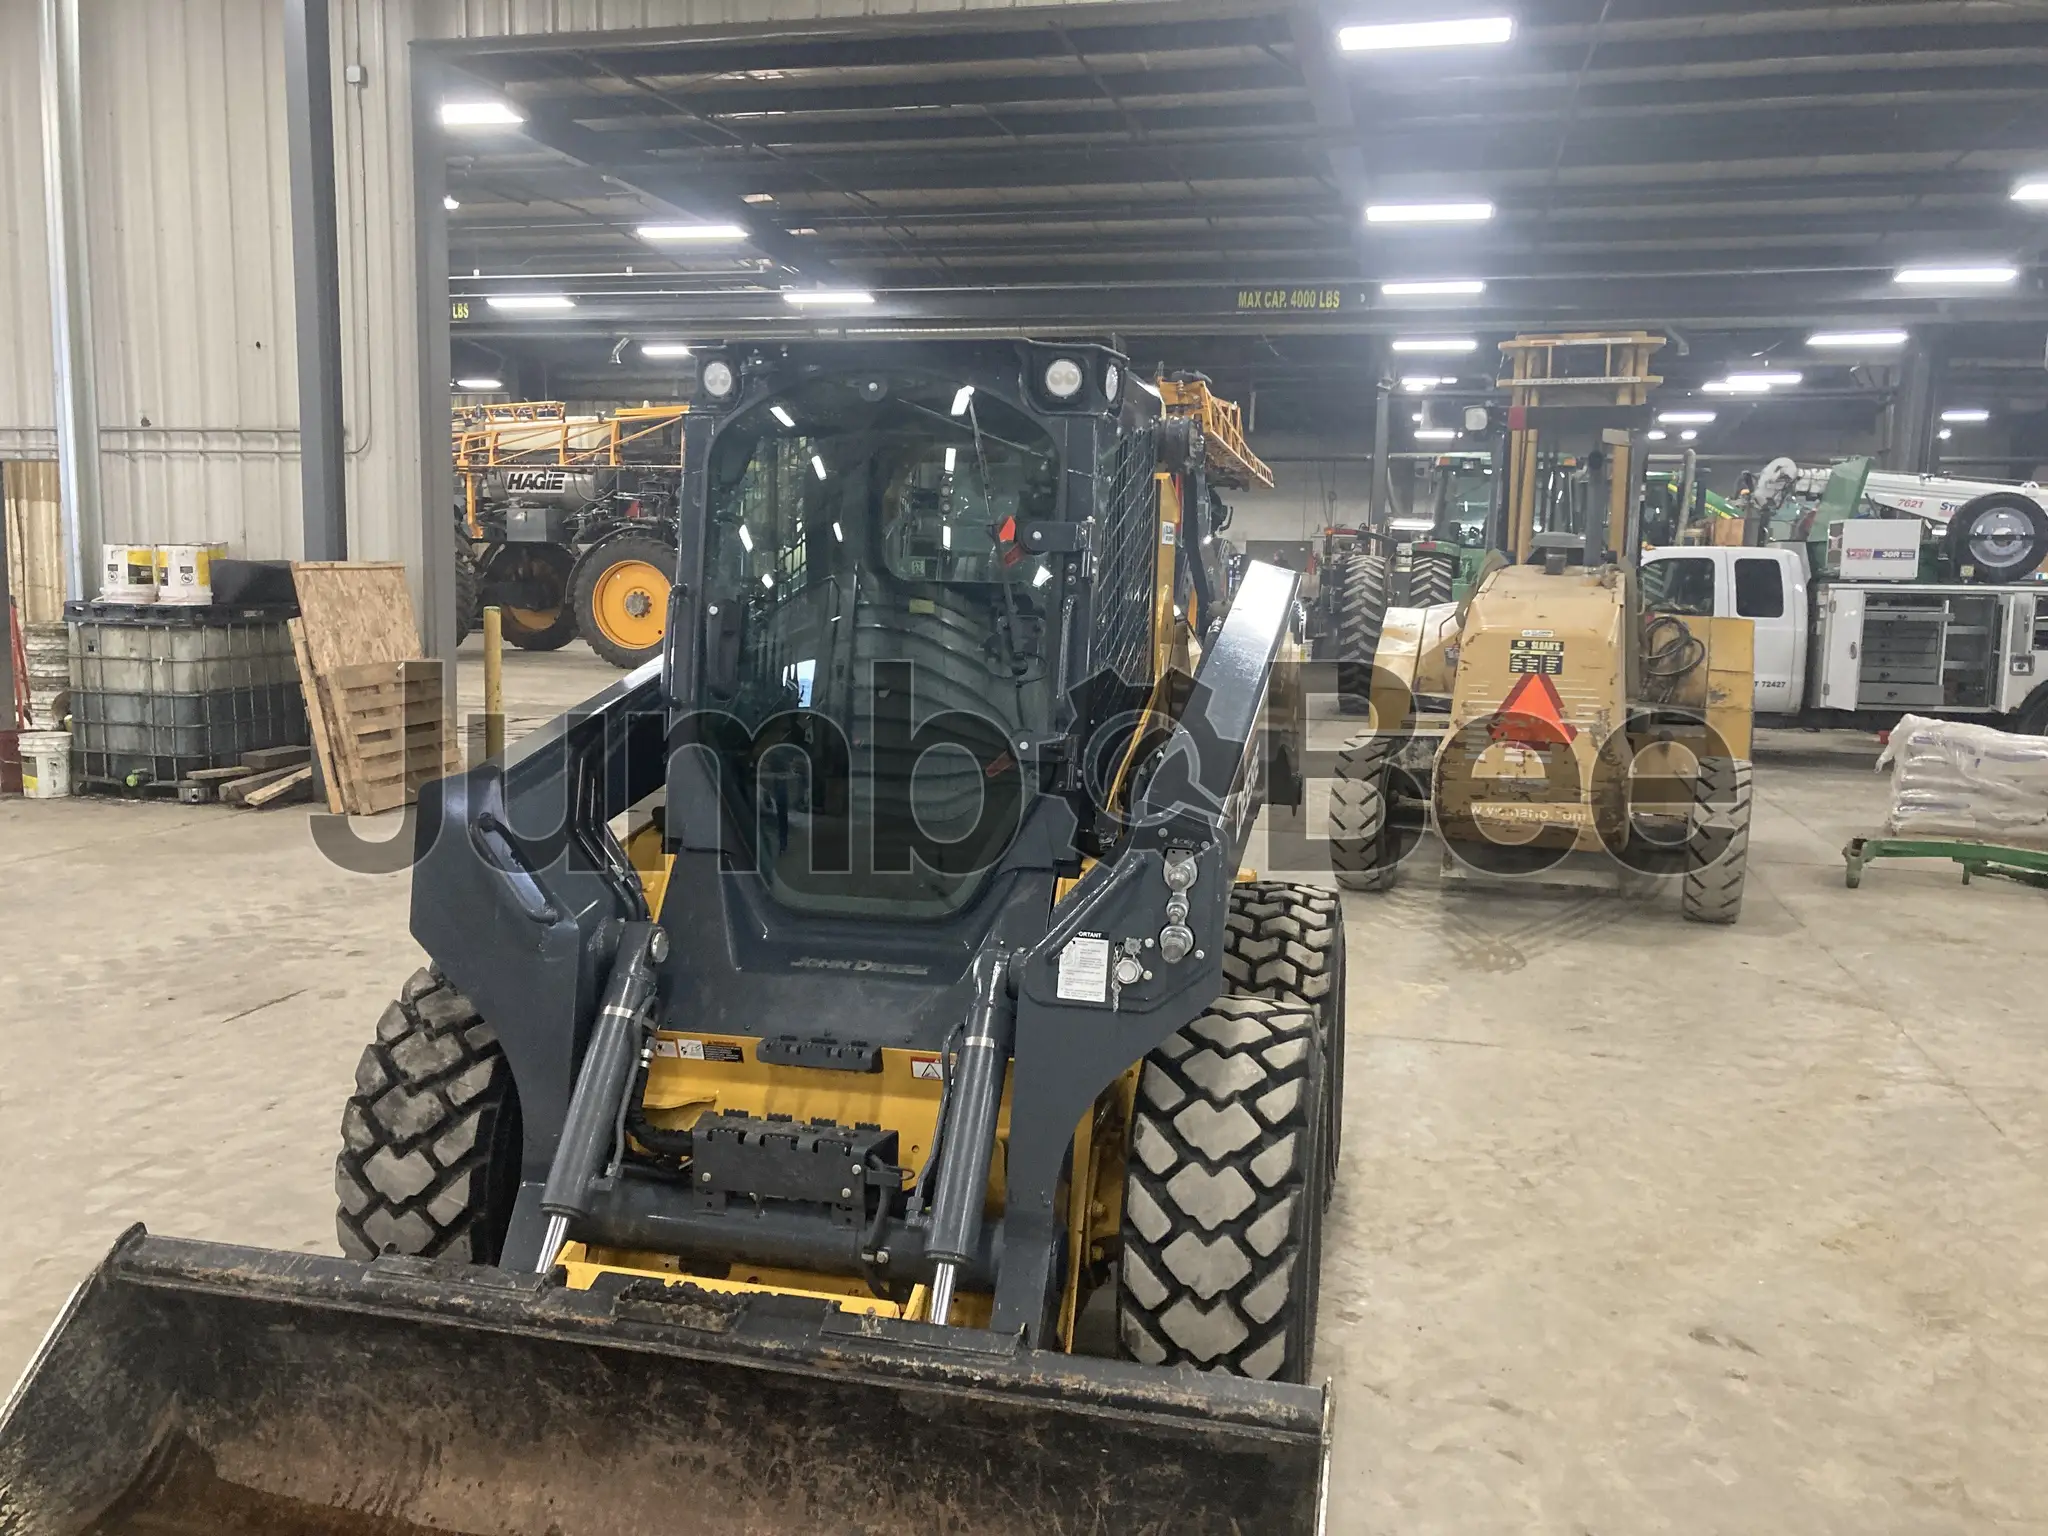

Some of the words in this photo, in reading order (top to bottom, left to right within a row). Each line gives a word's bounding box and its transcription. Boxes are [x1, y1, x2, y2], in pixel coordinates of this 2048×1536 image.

[1238, 291, 1262, 309] MAX
[1264, 291, 1287, 309] CAP.
[1290, 289, 1317, 309] 4000
[1319, 289, 1340, 308] LBS
[452, 302, 469, 319] LBS
[1897, 498, 1923, 509] 7621
[1761, 680, 1787, 688] 72427
